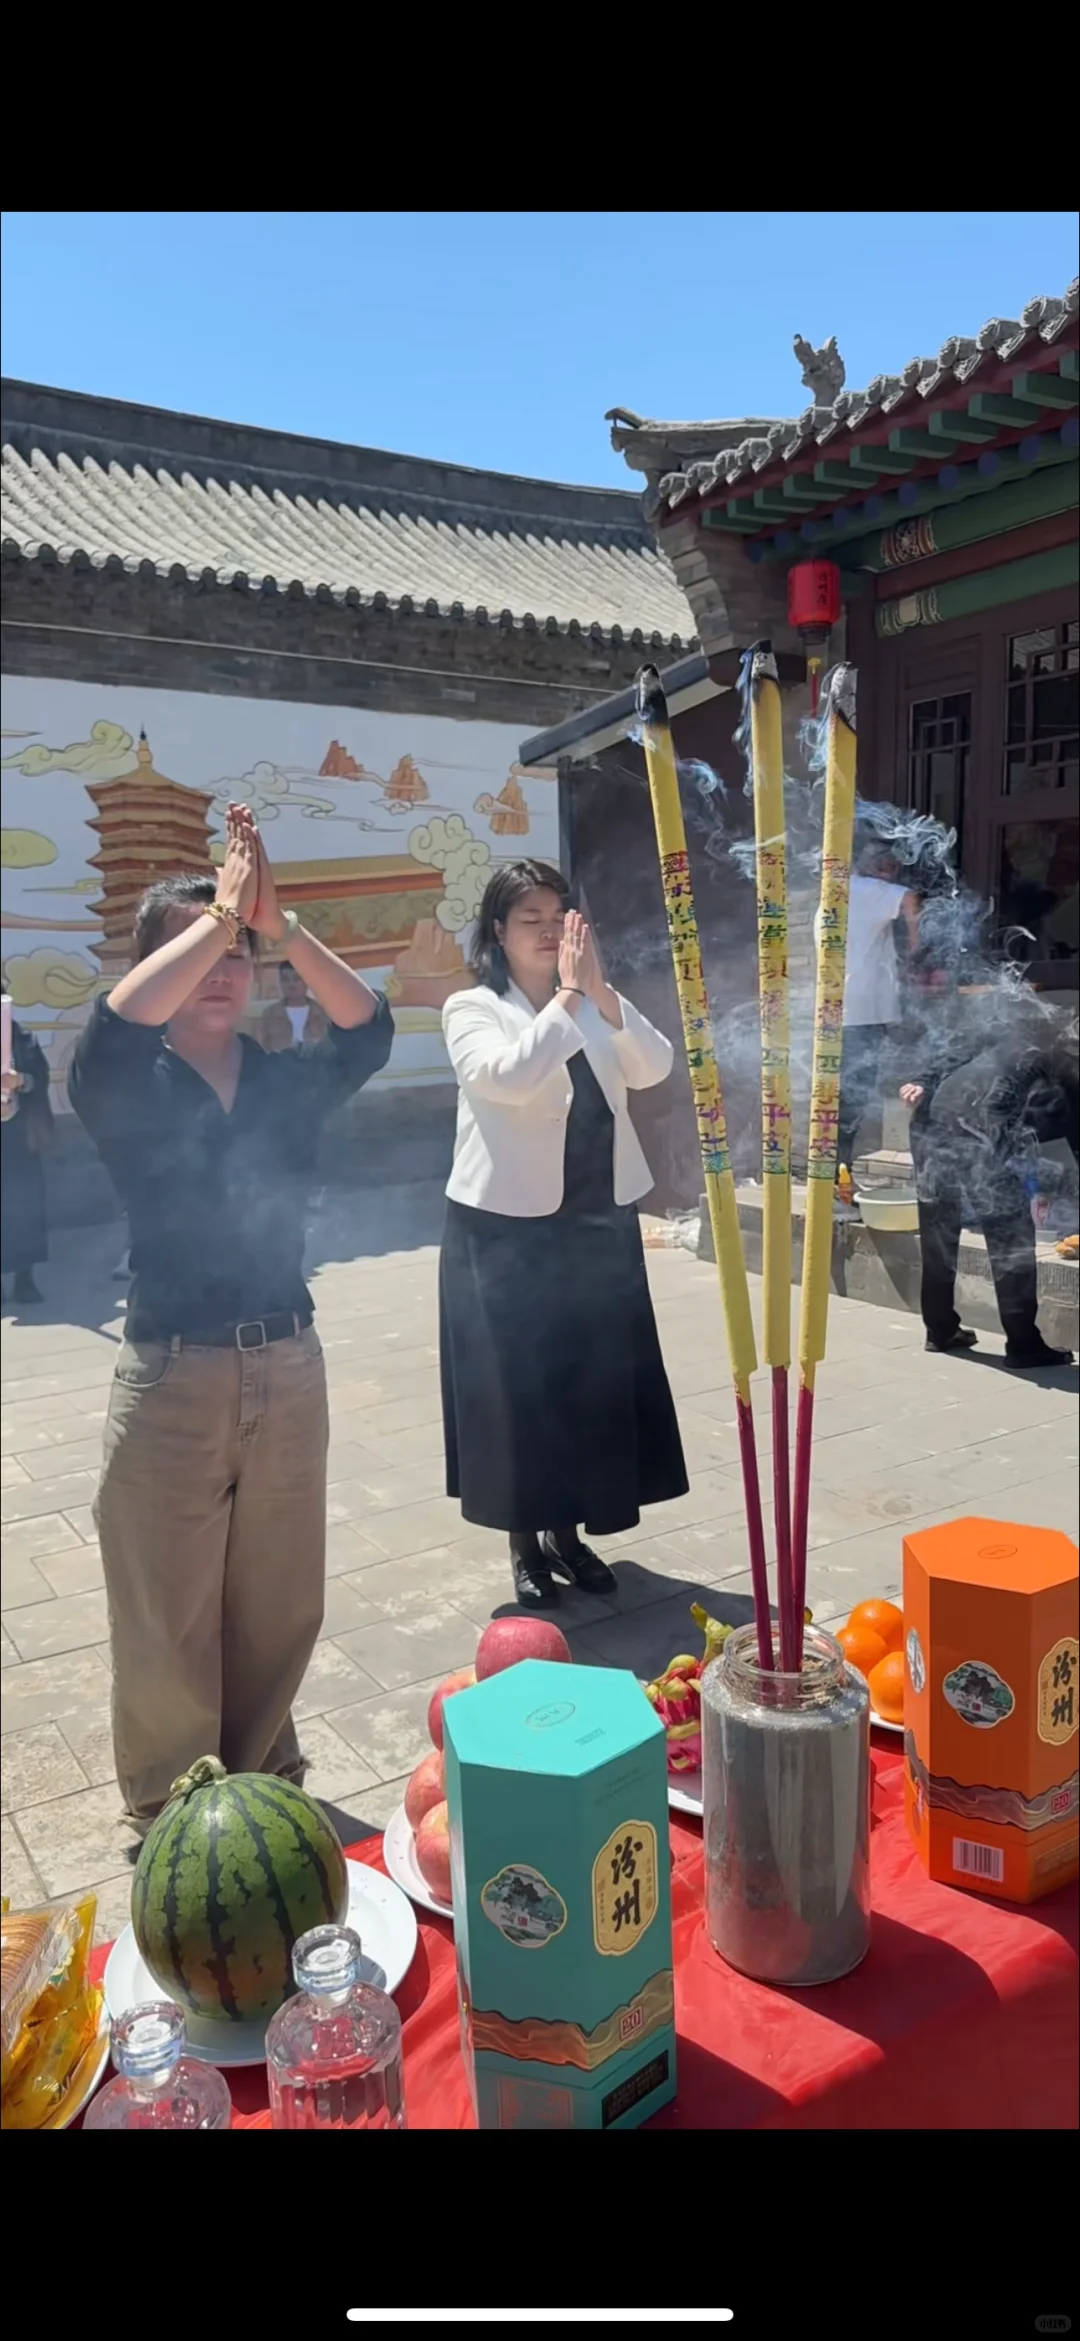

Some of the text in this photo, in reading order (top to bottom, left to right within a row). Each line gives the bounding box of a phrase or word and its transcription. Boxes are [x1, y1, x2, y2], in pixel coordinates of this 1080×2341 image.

[1051, 1649, 1077, 1728] 汾州
[610, 1835, 643, 1933] 汾州
[622, 2011, 641, 2033] 20
